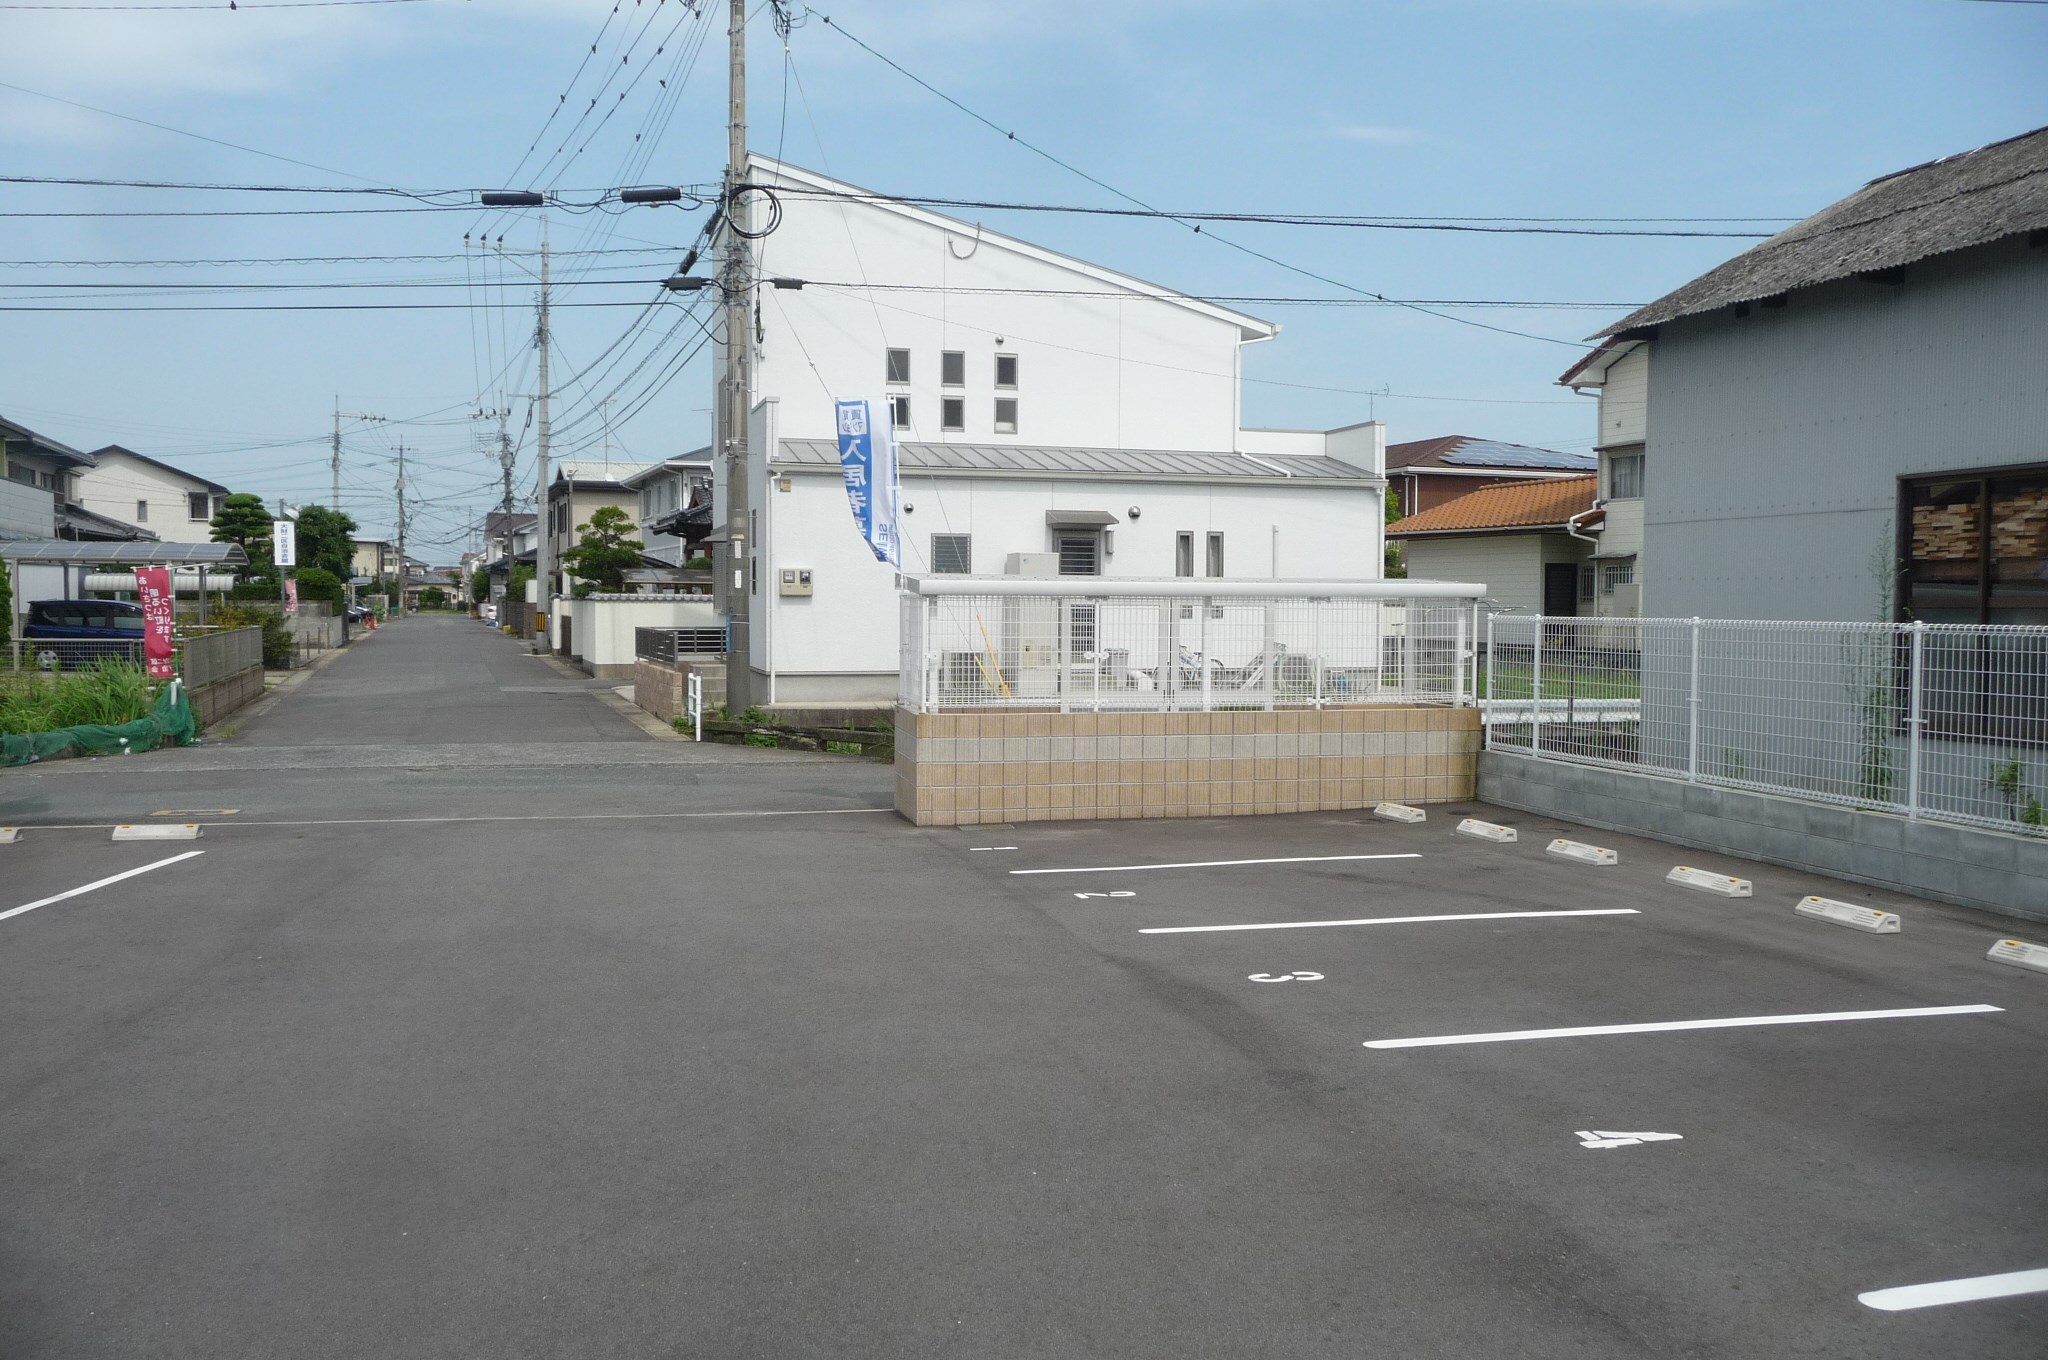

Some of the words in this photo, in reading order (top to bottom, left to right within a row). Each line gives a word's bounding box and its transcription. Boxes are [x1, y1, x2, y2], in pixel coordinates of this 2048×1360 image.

[1073, 891, 1136, 899] 2
[1248, 971, 1324, 983] 3
[1574, 1130, 1684, 1149] 4
